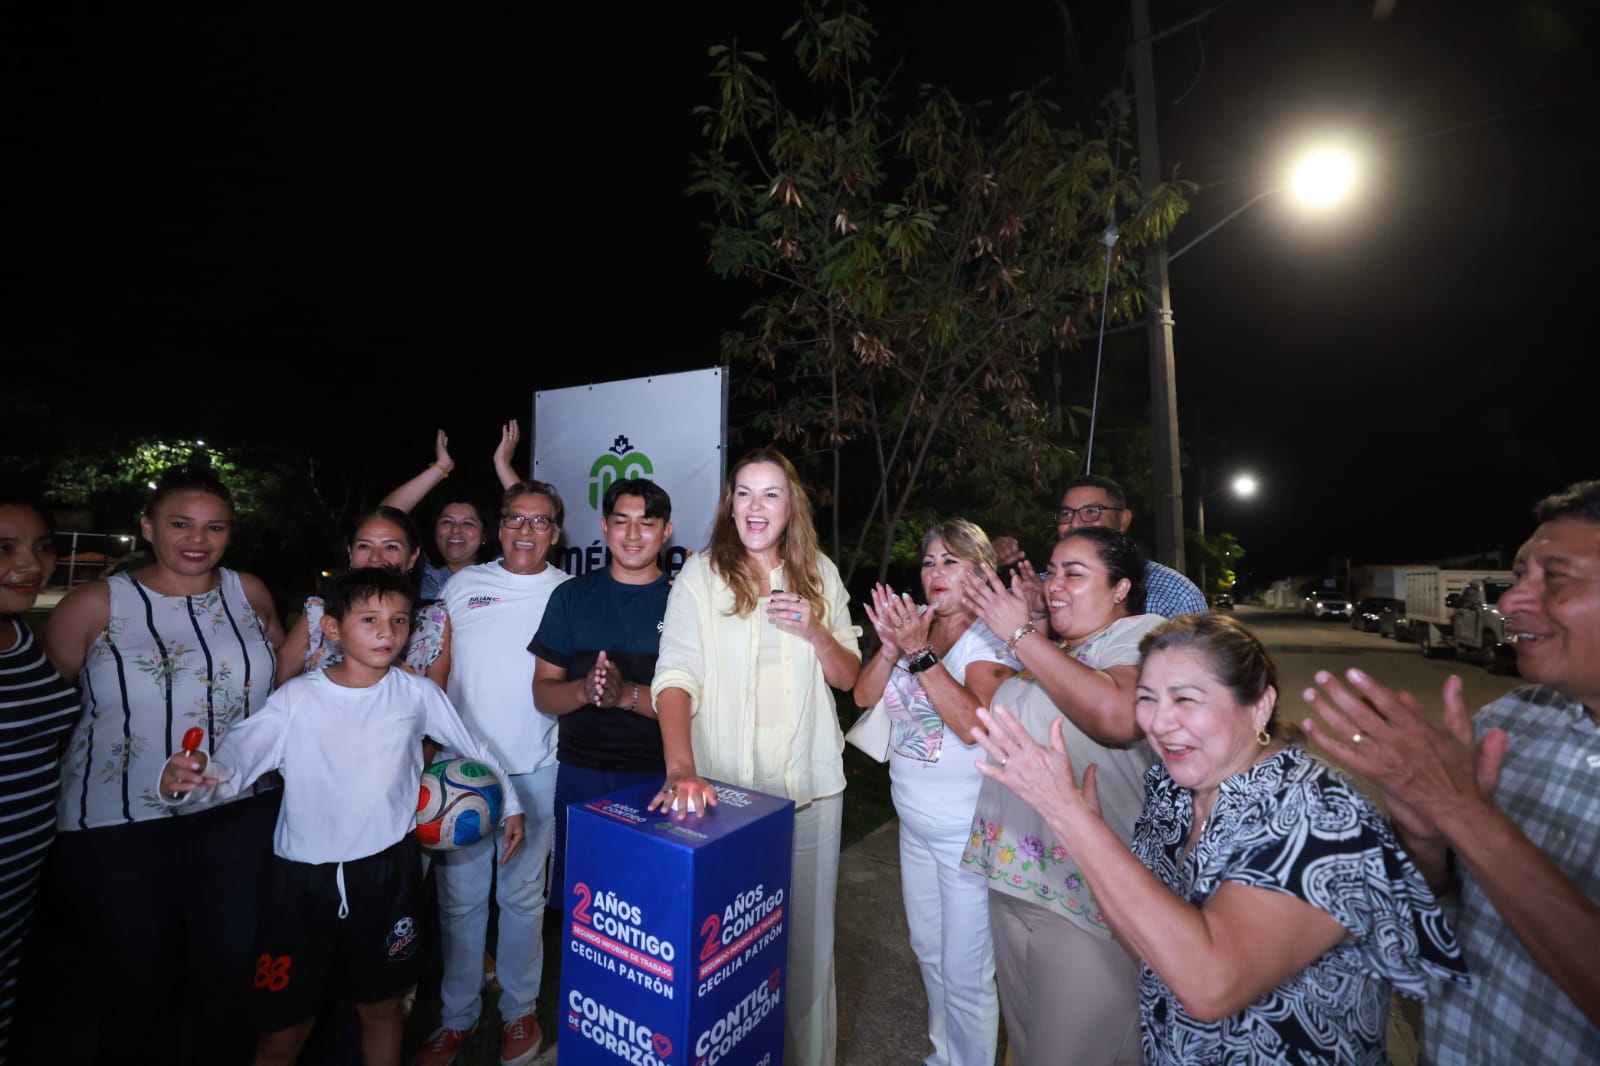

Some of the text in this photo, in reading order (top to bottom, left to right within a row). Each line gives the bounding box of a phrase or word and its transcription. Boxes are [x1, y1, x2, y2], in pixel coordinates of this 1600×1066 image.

[572, 881, 642, 925] 2 AÑOS
[699, 883, 764, 961] 2 AÑOS
[721, 888, 784, 945] CONTIGO
[573, 925, 672, 978] SEGUNDO INFORME DE TRABAJO
[592, 911, 675, 962] CONTIGO
[697, 922, 783, 998] CECILIA PATRÓN
[570, 940, 674, 1000] CECILIA PATRÓN
[700, 951, 729, 976] SEGUNDO
[568, 1014, 579, 1028] DE
